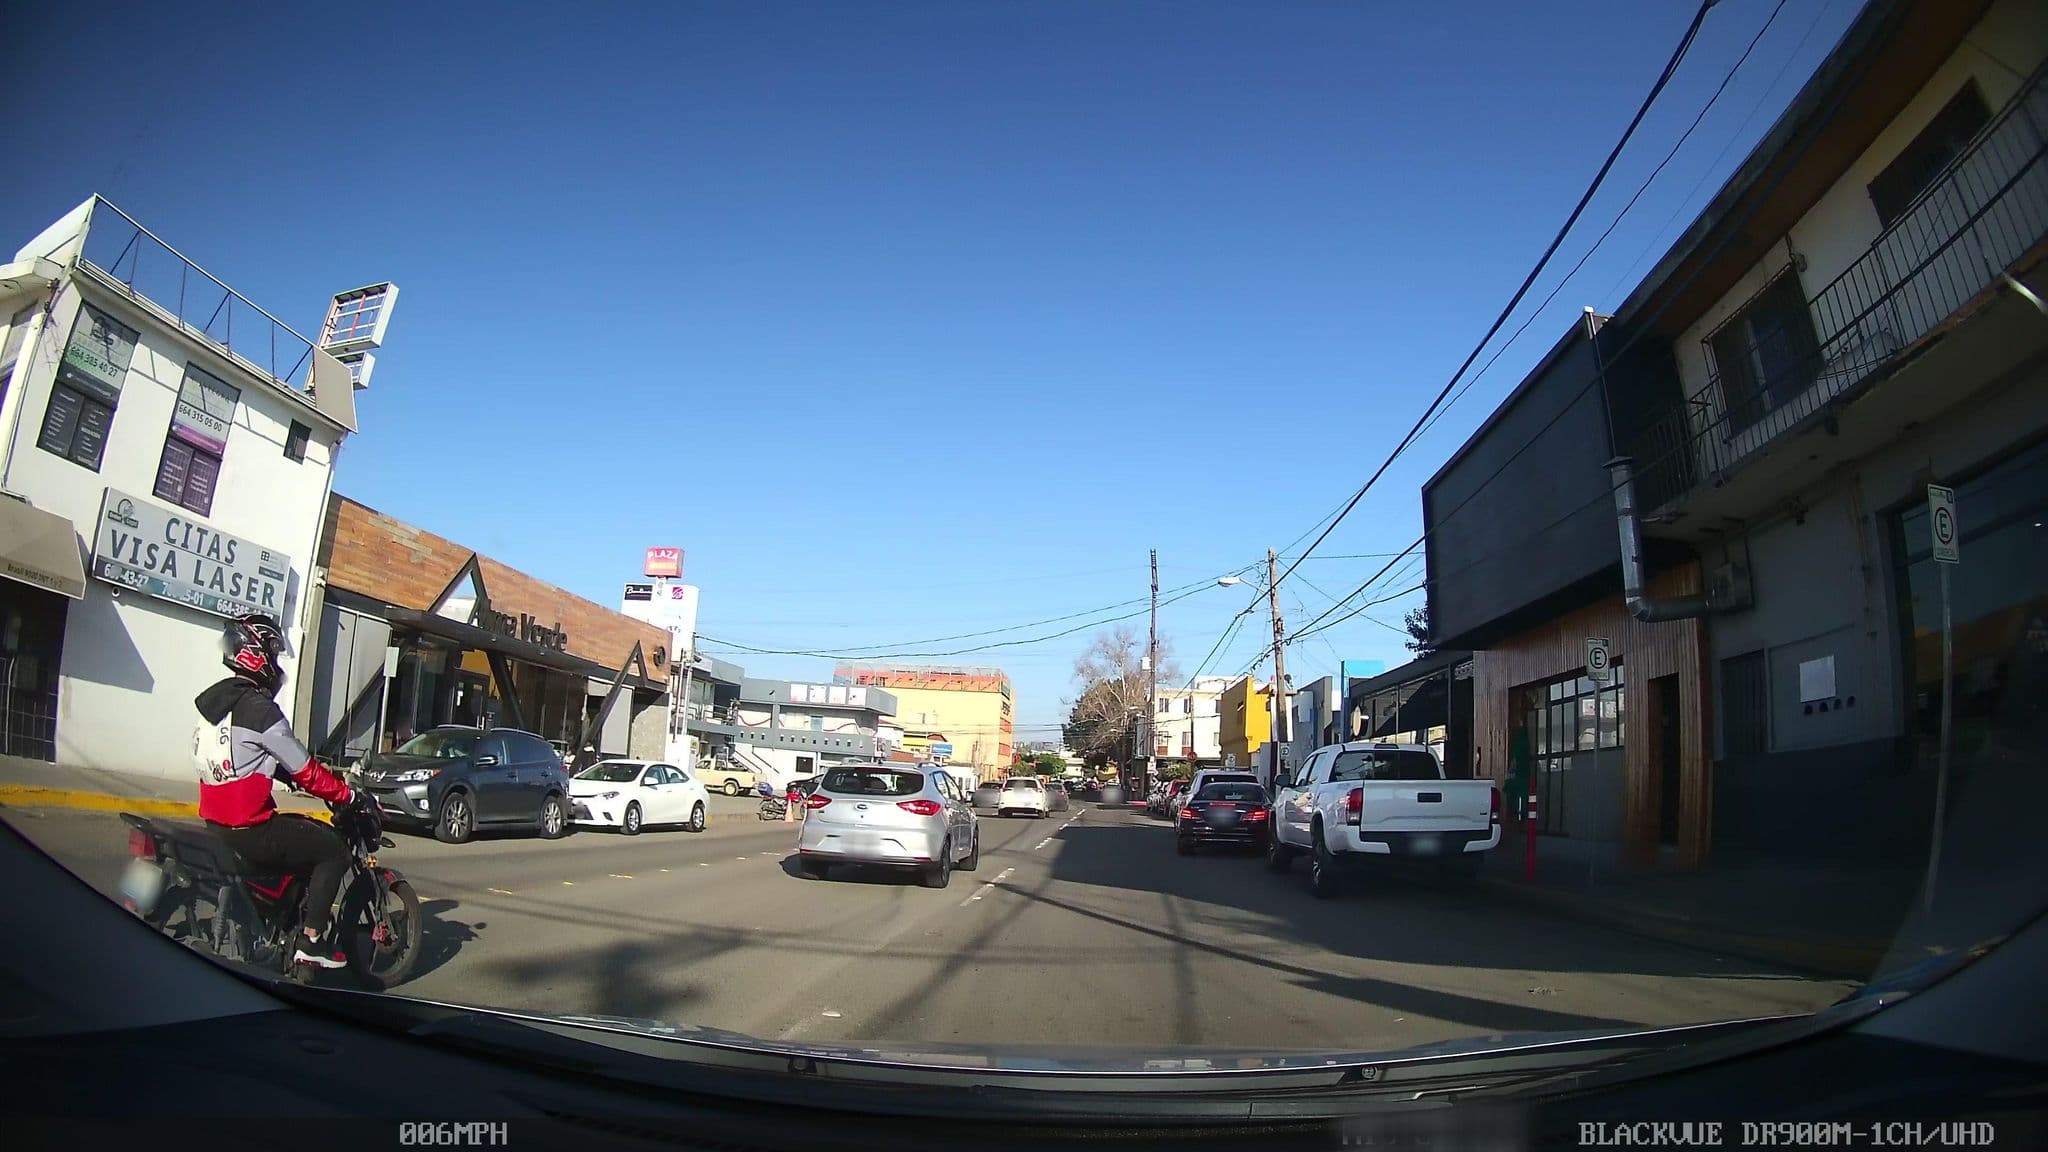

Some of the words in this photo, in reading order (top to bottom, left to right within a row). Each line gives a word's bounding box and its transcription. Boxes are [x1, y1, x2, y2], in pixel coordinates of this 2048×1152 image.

[179, 404, 191, 418] 664
[192, 411, 204, 424] 315
[213, 422, 222, 432] 00
[165, 518, 238, 564] CITAS
[104, 563, 149, 587] 6-43-27
[111, 529, 178, 578] VISA
[194, 560, 275, 608] LASER
